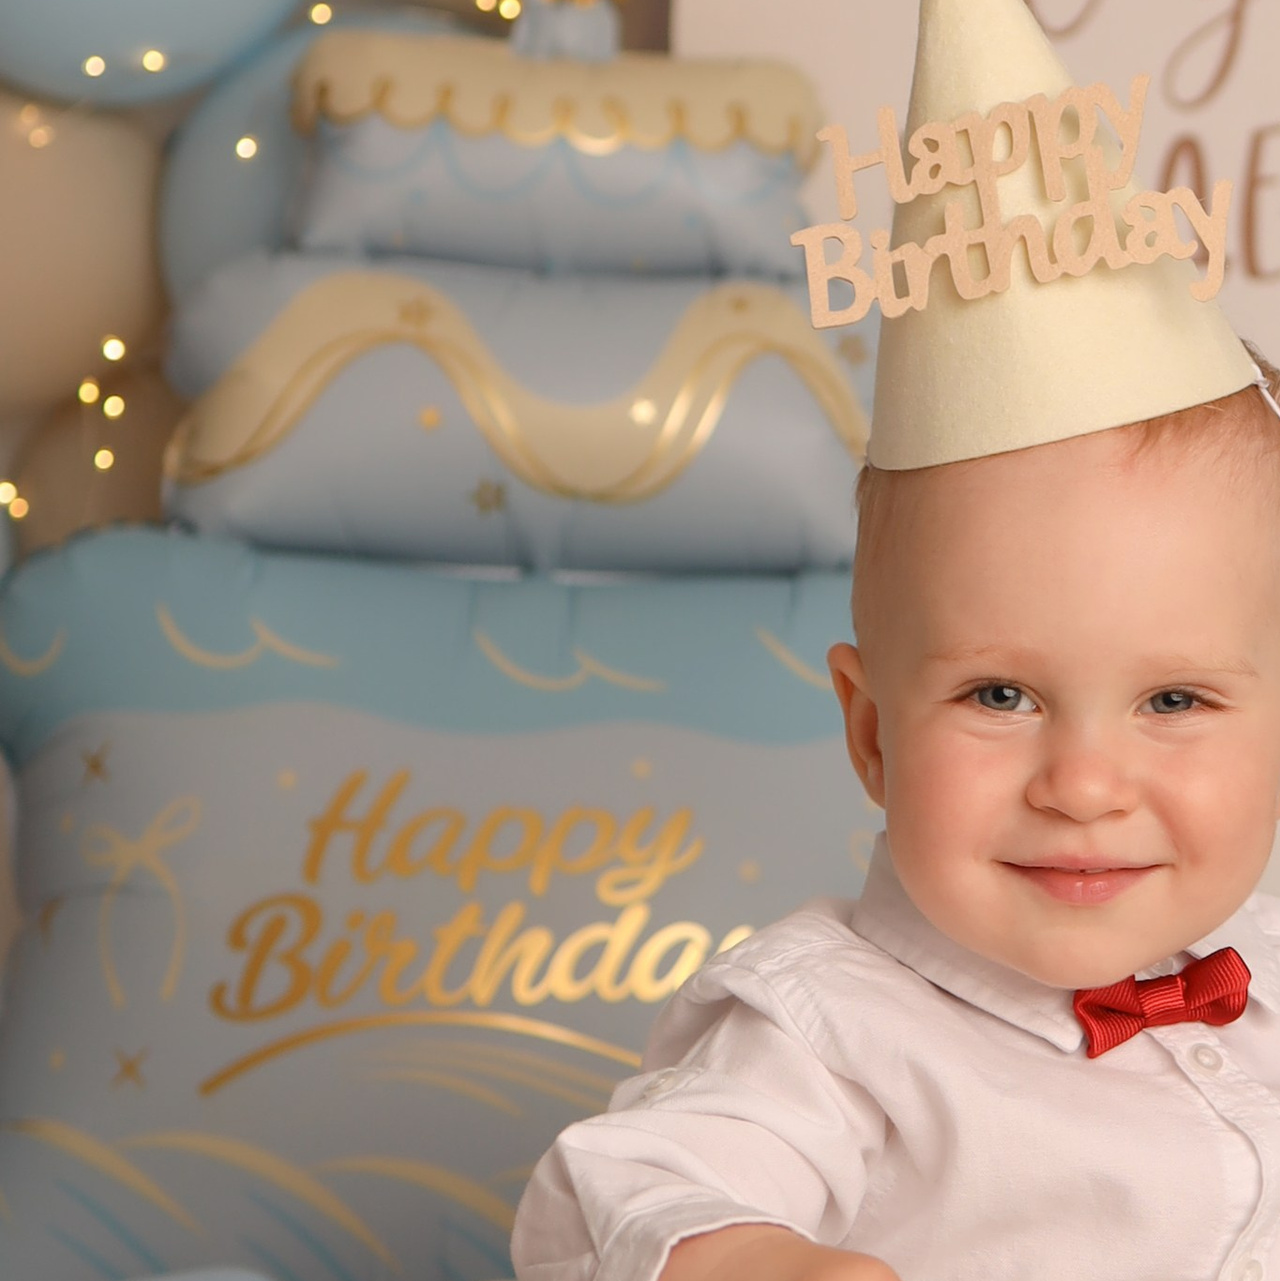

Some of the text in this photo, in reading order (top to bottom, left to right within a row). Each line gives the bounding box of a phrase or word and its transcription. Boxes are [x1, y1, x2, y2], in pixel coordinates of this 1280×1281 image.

[815, 72, 1151, 221] Happy
[789, 175, 1234, 330] Birthday
[303, 767, 706, 907] Happy
[210, 892, 756, 1024] Birthda
